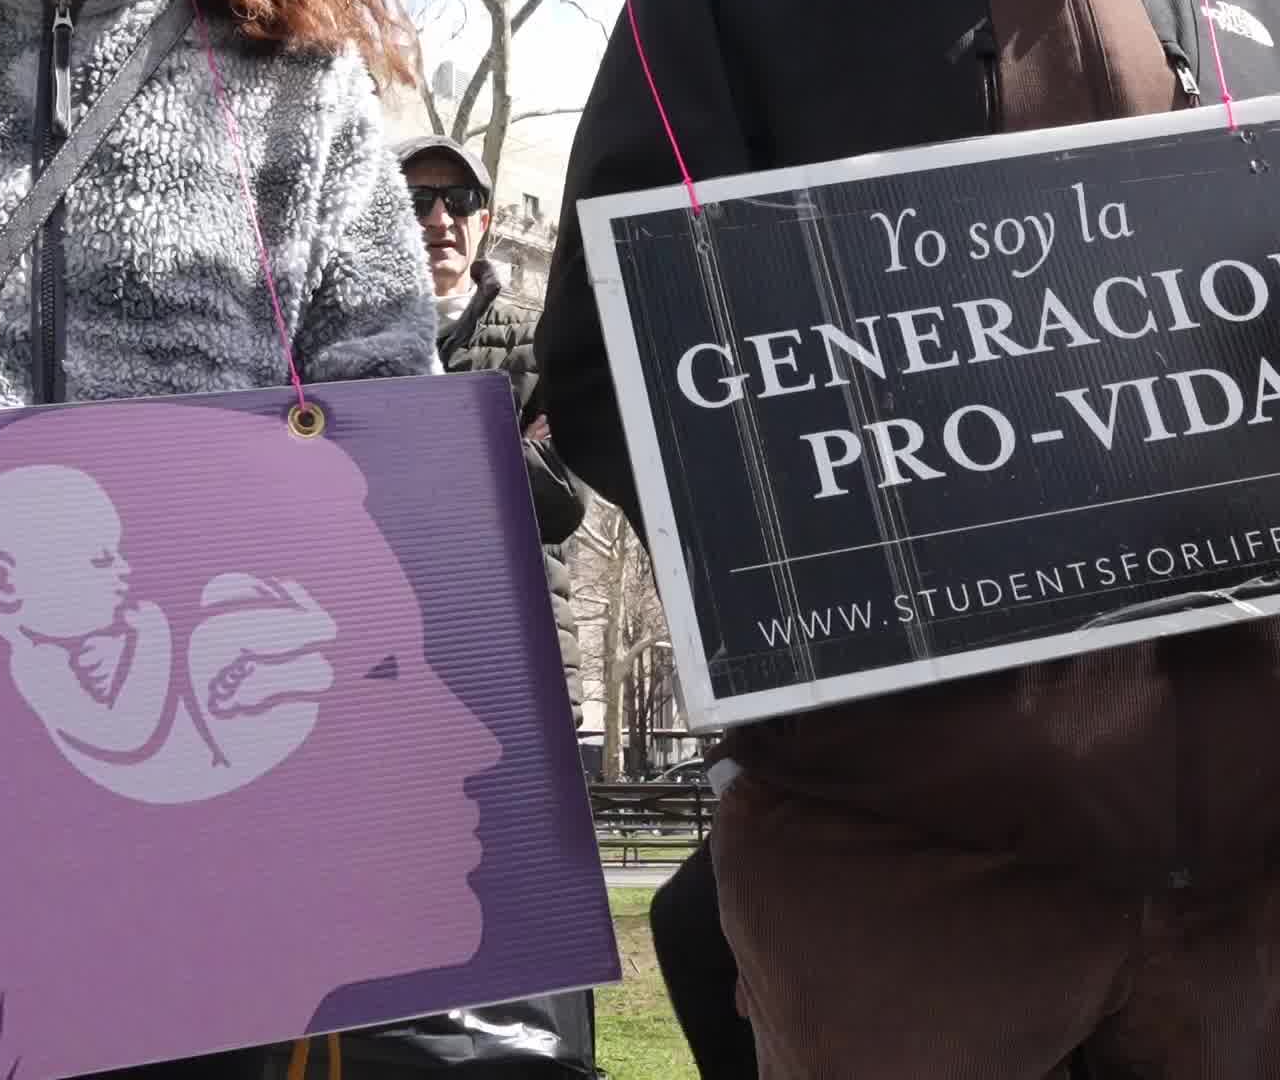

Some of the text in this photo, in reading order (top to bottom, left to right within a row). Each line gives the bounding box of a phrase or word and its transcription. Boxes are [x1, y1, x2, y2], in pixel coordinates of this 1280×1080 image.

[871, 182, 1134, 279] Yo soy la
